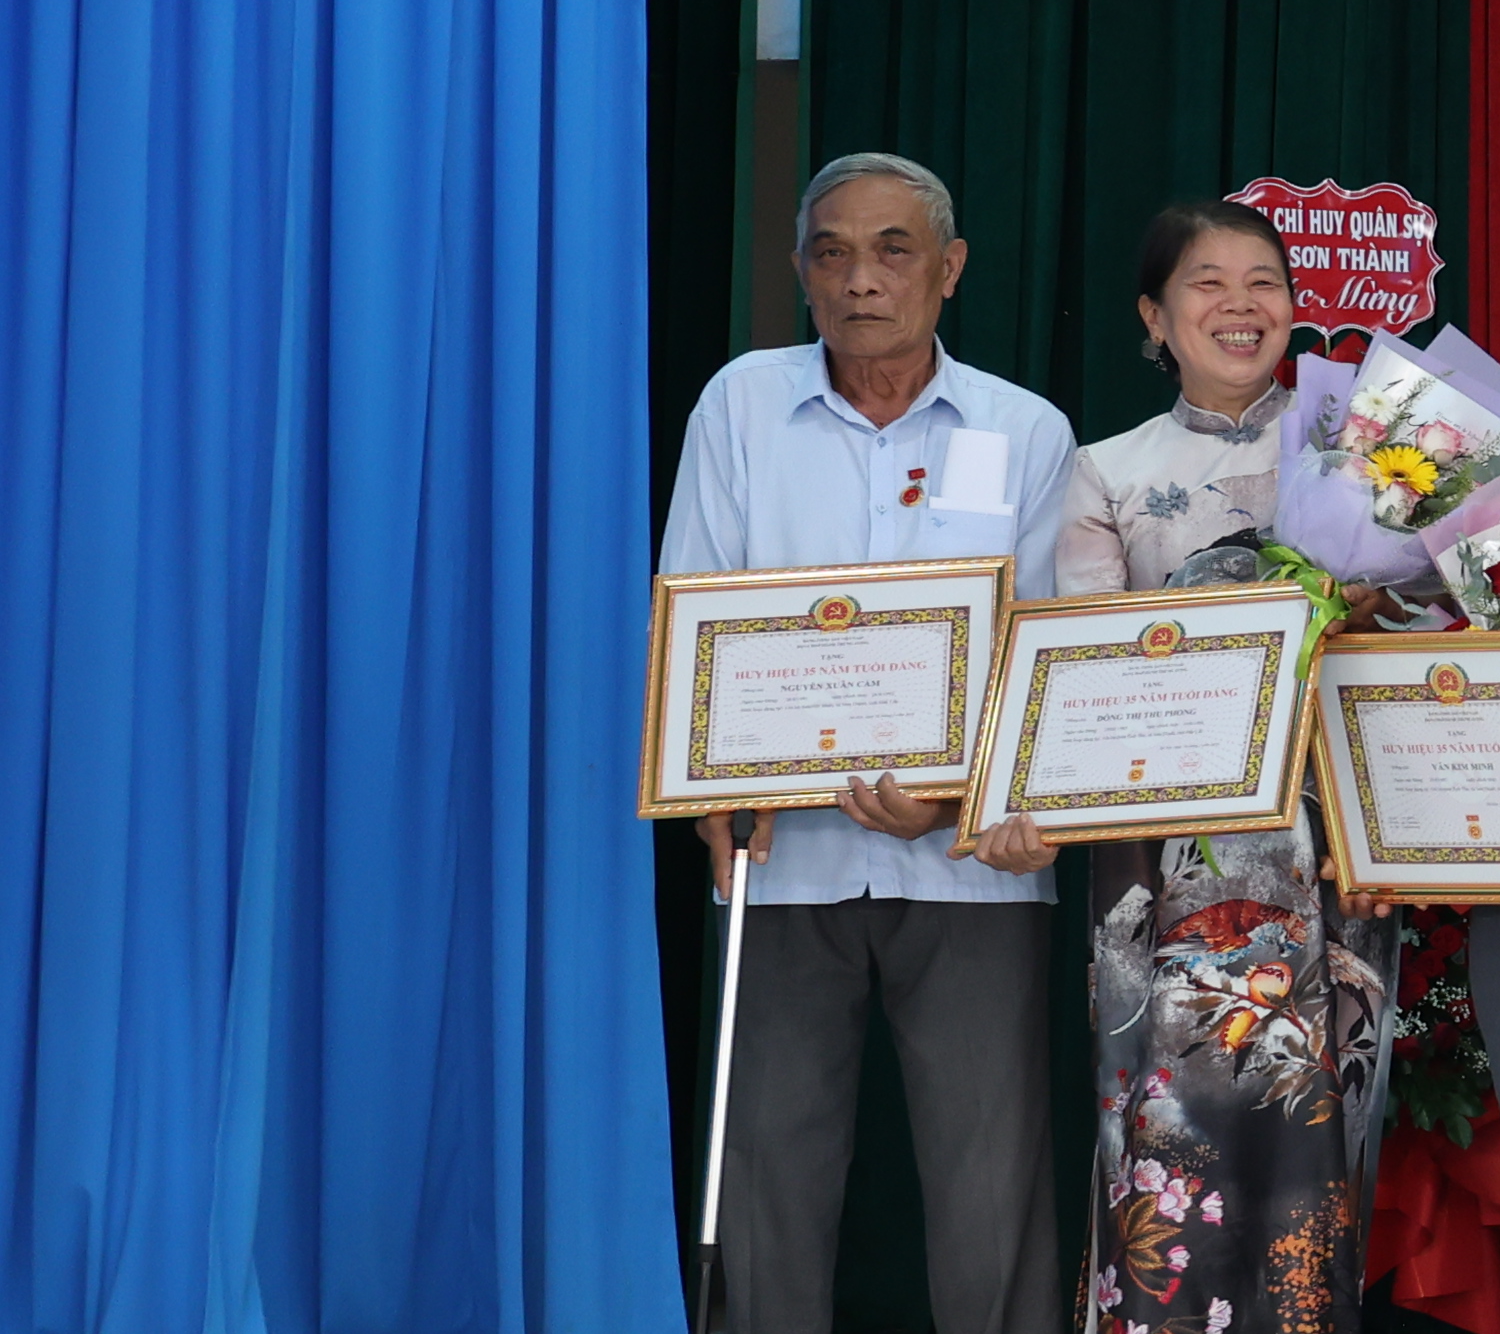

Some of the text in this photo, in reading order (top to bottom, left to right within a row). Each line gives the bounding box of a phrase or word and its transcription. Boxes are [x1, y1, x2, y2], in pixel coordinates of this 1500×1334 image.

[1273, 201, 1428, 248] CHỈ HUY QUÂN SỰ
[1289, 242, 1410, 273] SƠN THÀNH
[1319, 275, 1419, 325] Mừng
